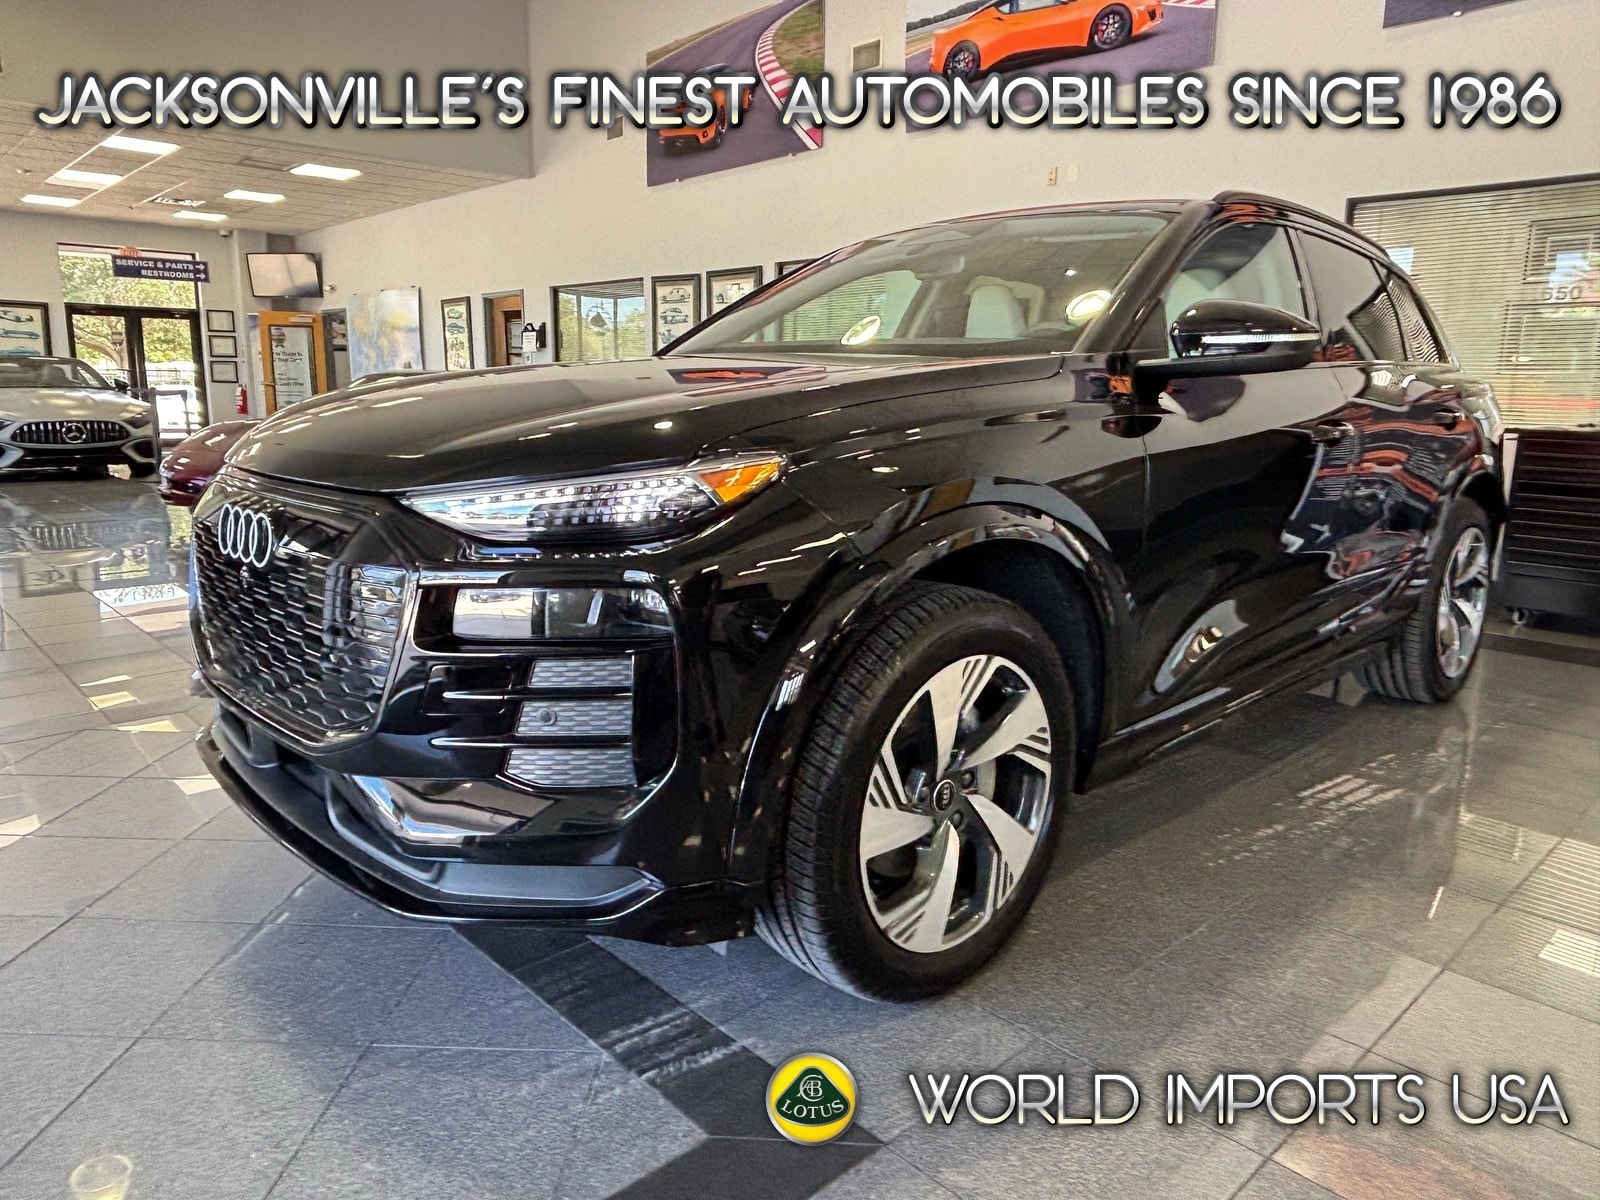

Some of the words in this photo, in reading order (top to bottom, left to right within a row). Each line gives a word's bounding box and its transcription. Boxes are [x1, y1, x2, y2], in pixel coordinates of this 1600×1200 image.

[115, 258, 155, 268] SERVICE
[156, 260, 164, 268] &
[165, 261, 195, 270] PARTS
[140, 269, 195, 279] RESTROOMS
